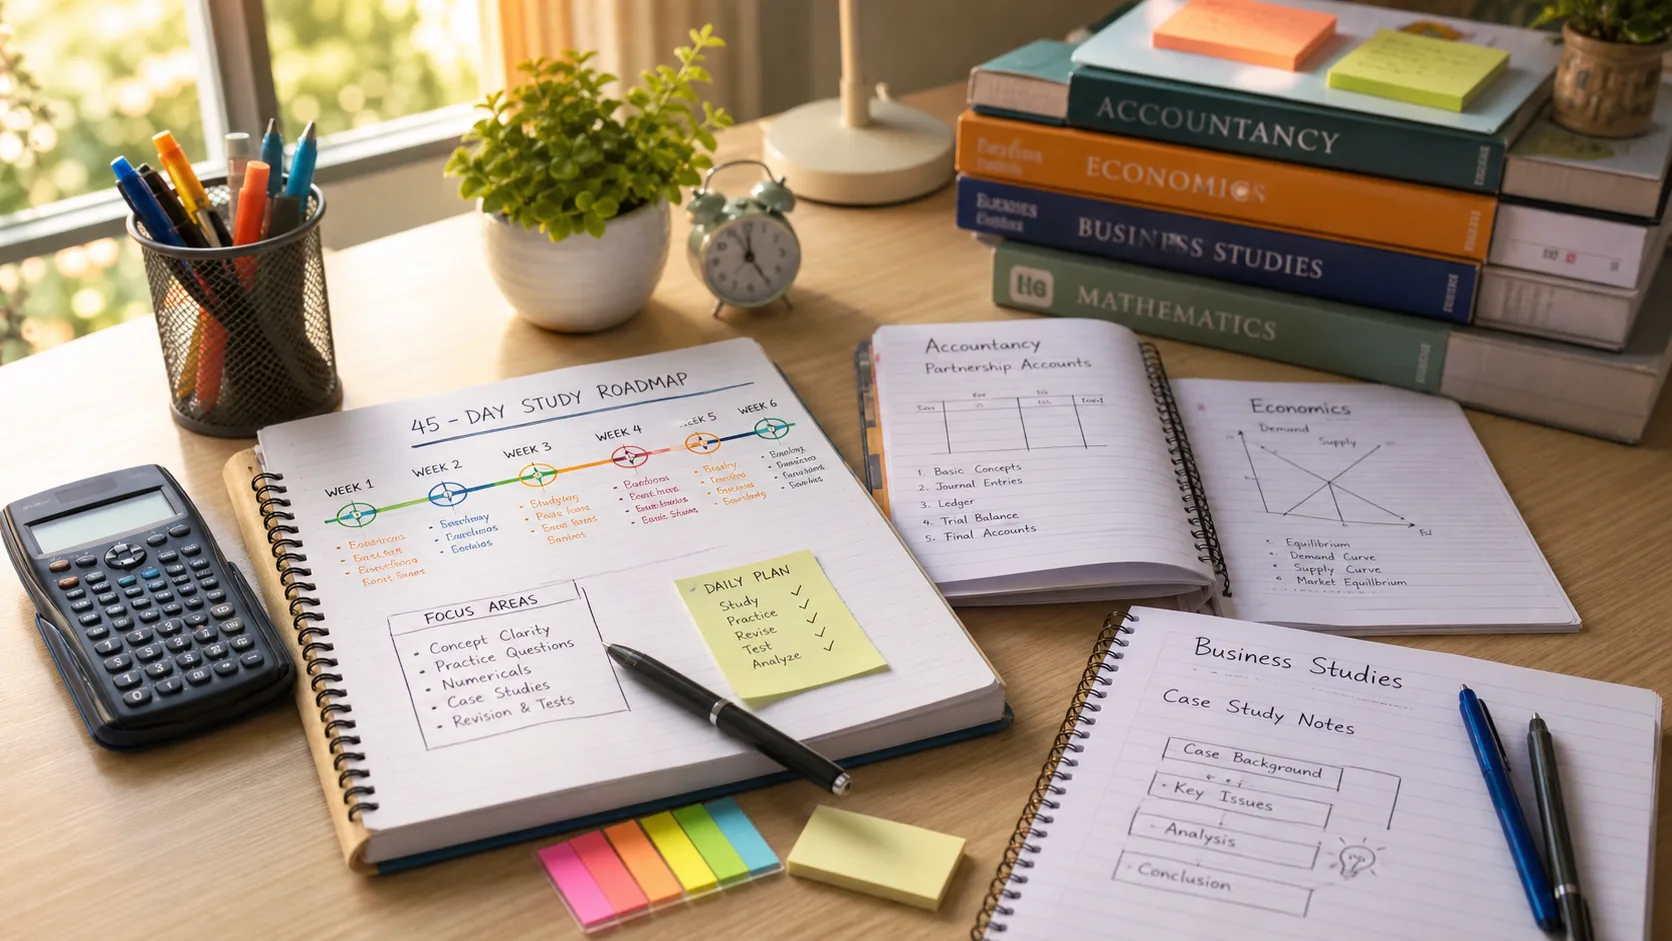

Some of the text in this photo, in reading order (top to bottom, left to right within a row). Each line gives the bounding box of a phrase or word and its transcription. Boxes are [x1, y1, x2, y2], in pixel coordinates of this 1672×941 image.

[1096, 95, 1341, 155] ACCOUNTANCY
[1085, 156, 1267, 203] ECONOMICS
[1213, 242, 1324, 279] STUDIES
[1077, 284, 1277, 341] MATHEMATICS
[925, 338, 1041, 353] Accountancy
[925, 357, 1092, 375] Partnership Accounts
[411, 416, 440, 435] 45
[465, 404, 505, 427] DAY
[521, 390, 581, 414] STUDY
[597, 372, 687, 400] ROADMAP
[737, 399, 777, 415] WEEK 6
[1250, 398, 1351, 416] Economics
[709, 412, 717, 422] 5
[595, 425, 642, 442] WEEK 4
[1259, 423, 1309, 433] Demand
[503, 442, 551, 459] WEEK 3
[1319, 436, 1356, 448] Supply
[412, 459, 462, 478] WEEK 2
[934, 466, 964, 476] Basic
[975, 462, 1022, 475] Concepts
[325, 479, 374, 498] WEEK 1
[936, 480, 975, 491] Journal
[984, 476, 1023, 488] Entries
[921, 498, 975, 509] 3. Ledger
[940, 515, 968, 526] Trial
[975, 511, 1019, 523] Balance
[944, 529, 974, 541] Final
[983, 523, 1037, 538] Accounts
[1290, 551, 1376, 561] Demand Curve
[1294, 564, 1382, 576] Supply Curve
[704, 564, 790, 595] DAILY PLAN
[1296, 576, 1336, 586] Market
[424, 594, 538, 624] FOCUS AREAS
[719, 595, 758, 612] Study
[727, 609, 778, 627] Practice
[430, 624, 550, 655] Concept Clarity
[735, 625, 778, 641] Revise
[435, 637, 575, 673] Practice Questions
[742, 641, 773, 655] Test
[752, 652, 802, 670] Analyze
[1194, 636, 1403, 690] Business Studies
[442, 664, 532, 691] Numericals
[447, 679, 550, 709] Case Studies
[452, 694, 575, 728] Revision & Tests
[1162, 688, 1356, 736] Case Study Notes
[1183, 742, 1322, 780] Case Background
[1174, 781, 1273, 812] Key Issues
[1164, 821, 1236, 848] Analysis
[1137, 862, 1232, 892] Conclusion
